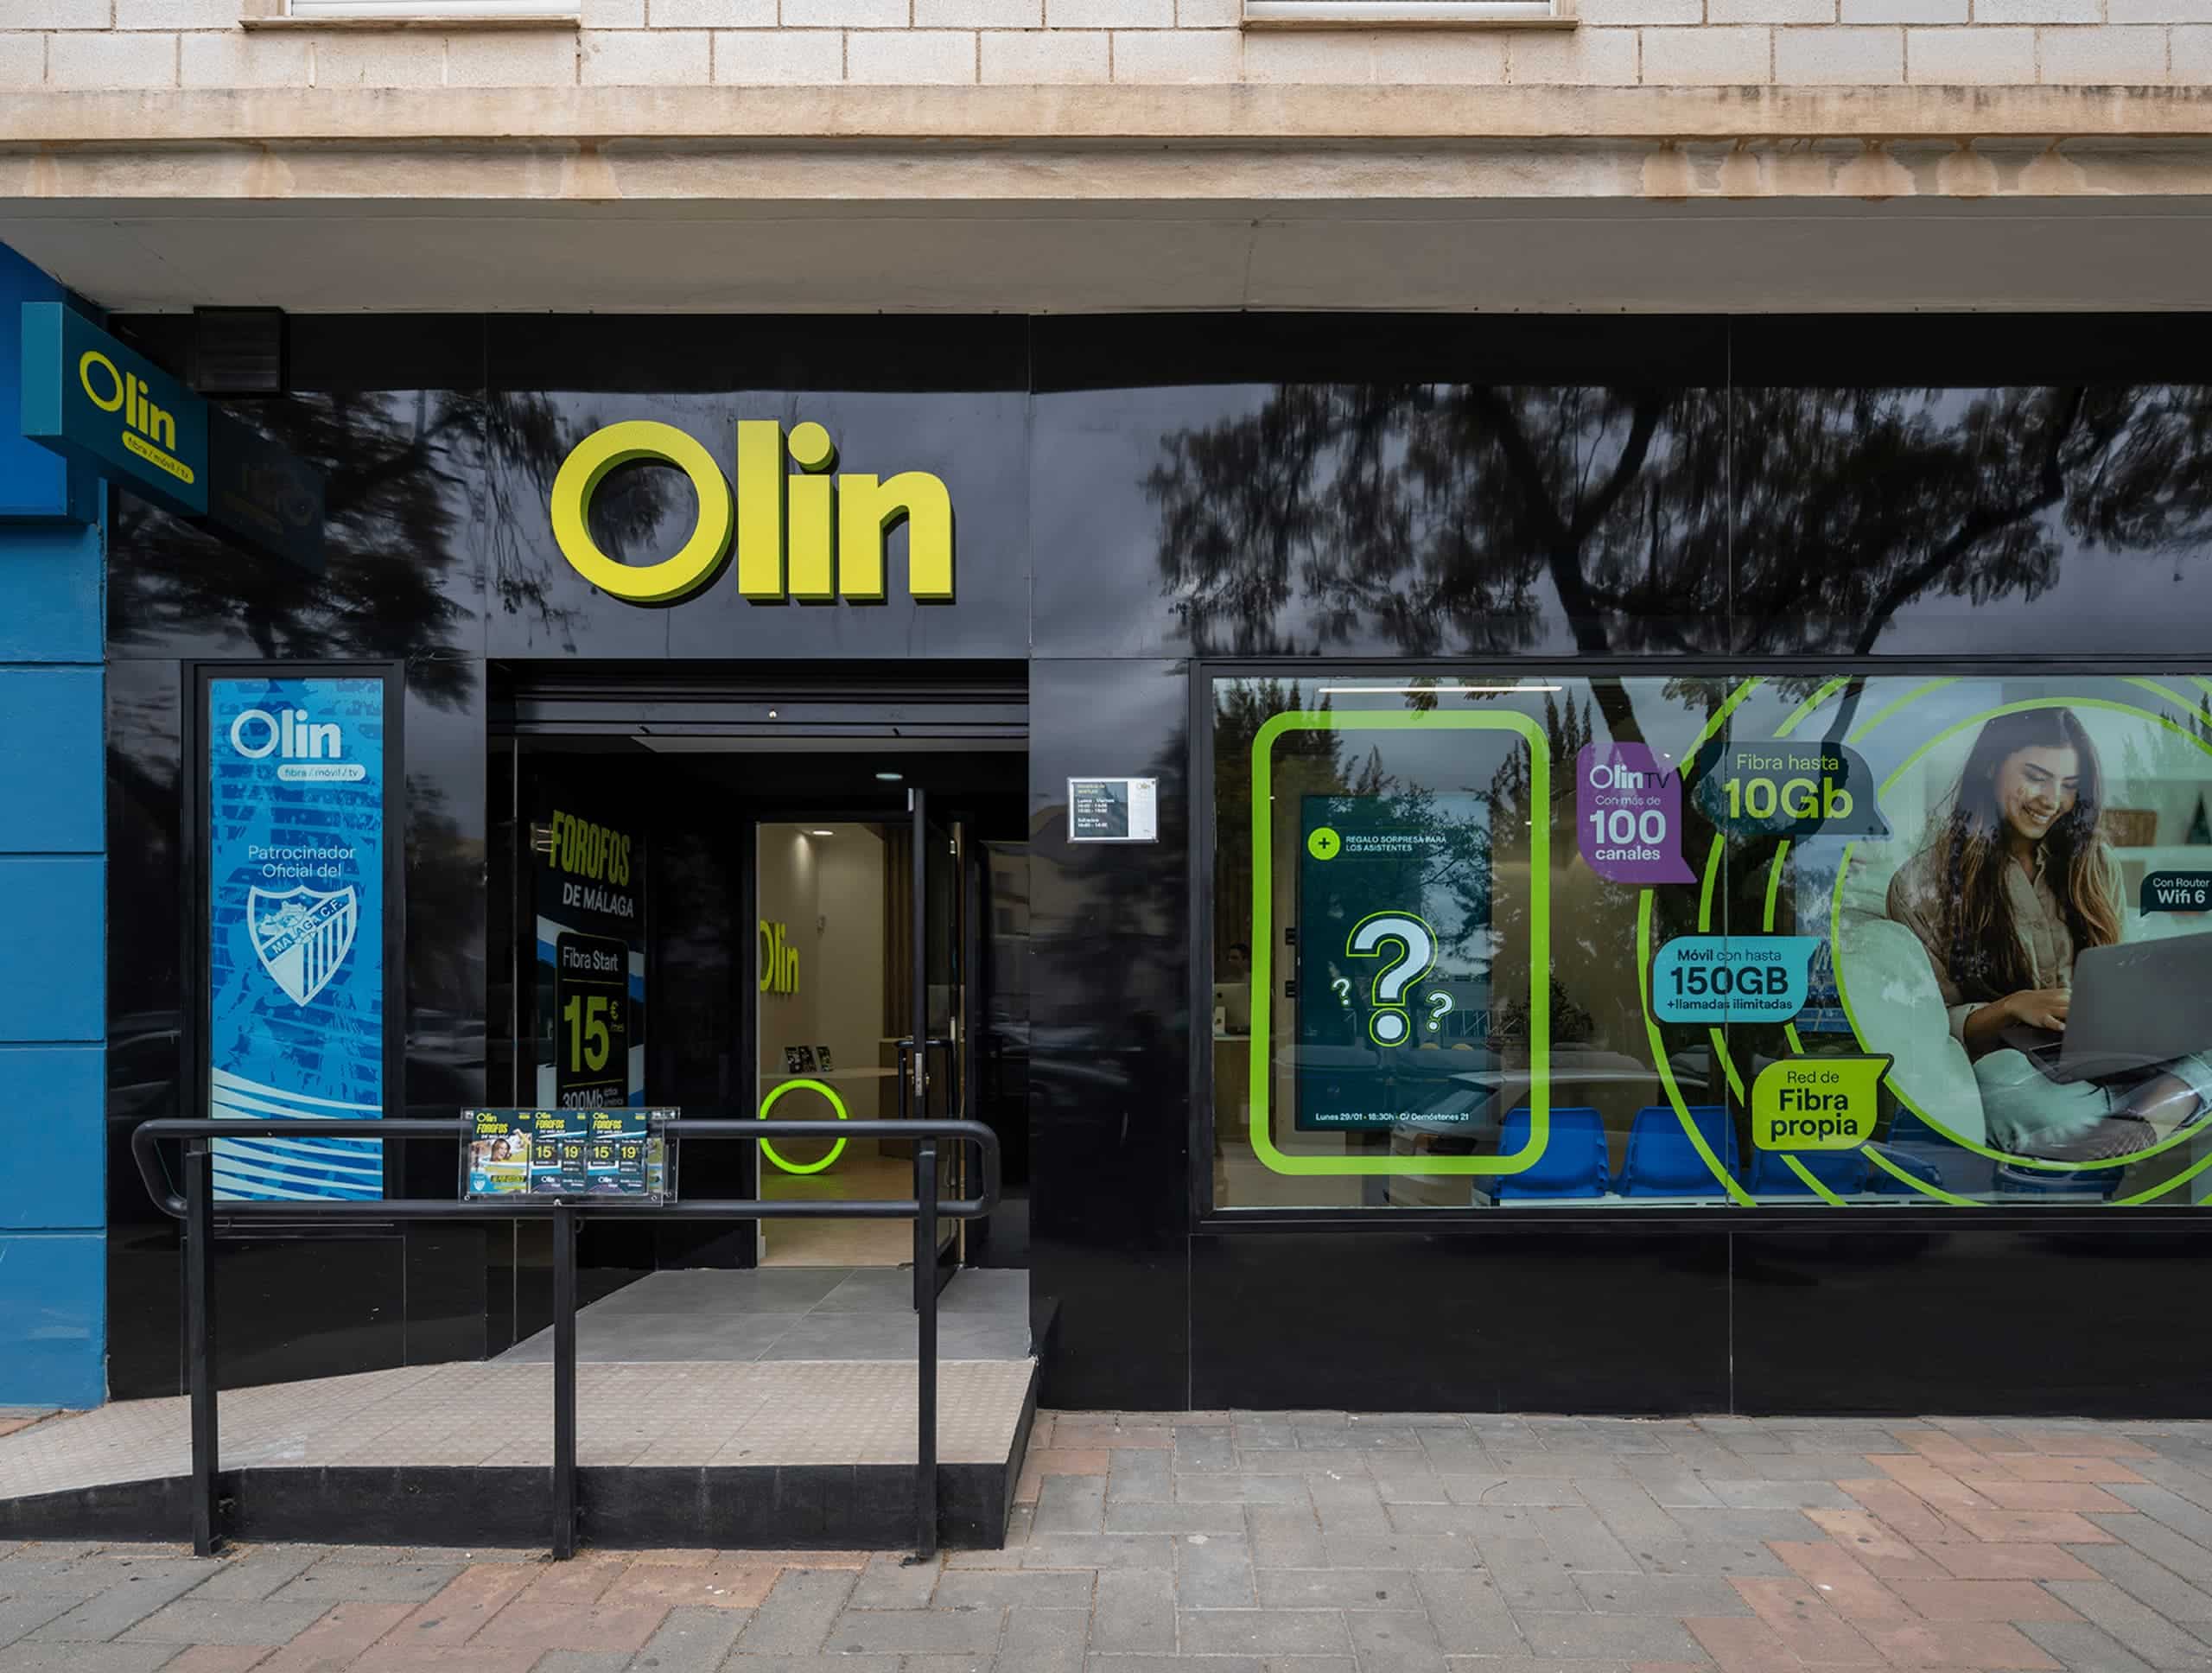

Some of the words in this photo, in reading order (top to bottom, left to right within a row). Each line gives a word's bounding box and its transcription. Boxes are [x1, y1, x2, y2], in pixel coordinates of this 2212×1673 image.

[79, 350, 175, 451] Olin
[551, 420, 954, 602] Olin
[231, 709, 341, 758] Olin
[1737, 754, 1783, 771] Fibra
[1789, 754, 1840, 771] hasta
[284, 768, 307, 777] fibra
[315, 768, 340, 777] móvil
[1595, 795, 1618, 806] Con
[1620, 794, 1643, 806] más
[1646, 795, 1661, 806] de
[1724, 776, 1853, 820] 10Gb
[1590, 809, 1666, 844] 100
[249, 844, 356, 860] Patrocinador
[550, 809, 632, 887] FOROFOS
[1595, 846, 1661, 861] canales
[262, 863, 313, 878] Oficial
[316, 863, 342, 878] del
[2152, 877, 2174, 887] Con
[2176, 877, 2210, 887] Router
[563, 882, 582, 907] DE
[582, 884, 634, 919] MÁLAGA
[2157, 889, 2190, 904] Wifi
[2194, 889, 2206, 904] 6
[563, 946, 591, 970] Fibra
[593, 949, 619, 971] Start
[1677, 949, 1713, 961] Móvil
[1716, 951, 1742, 962] con
[1745, 949, 1782, 962] hasta
[1670, 966, 1789, 996] 150GB
[1732, 999, 1793, 1010] ilimitadas
[1787, 1071, 1815, 1084] Red
[1820, 1071, 1840, 1084] de
[563, 1088, 604, 1110] 300Mb
[1779, 1088, 1848, 1111] Fibra
[476, 1112, 498, 1123] Olin
[535, 1119, 565, 1129] FOROFOS
[593, 1119, 622, 1129] FOROFOS
[1315, 1112, 1338, 1121] Lunes
[1340, 1112, 1363, 1121] 29/01
[1460, 1112, 1469, 1121] 21
[1770, 1113, 1858, 1142] propia
